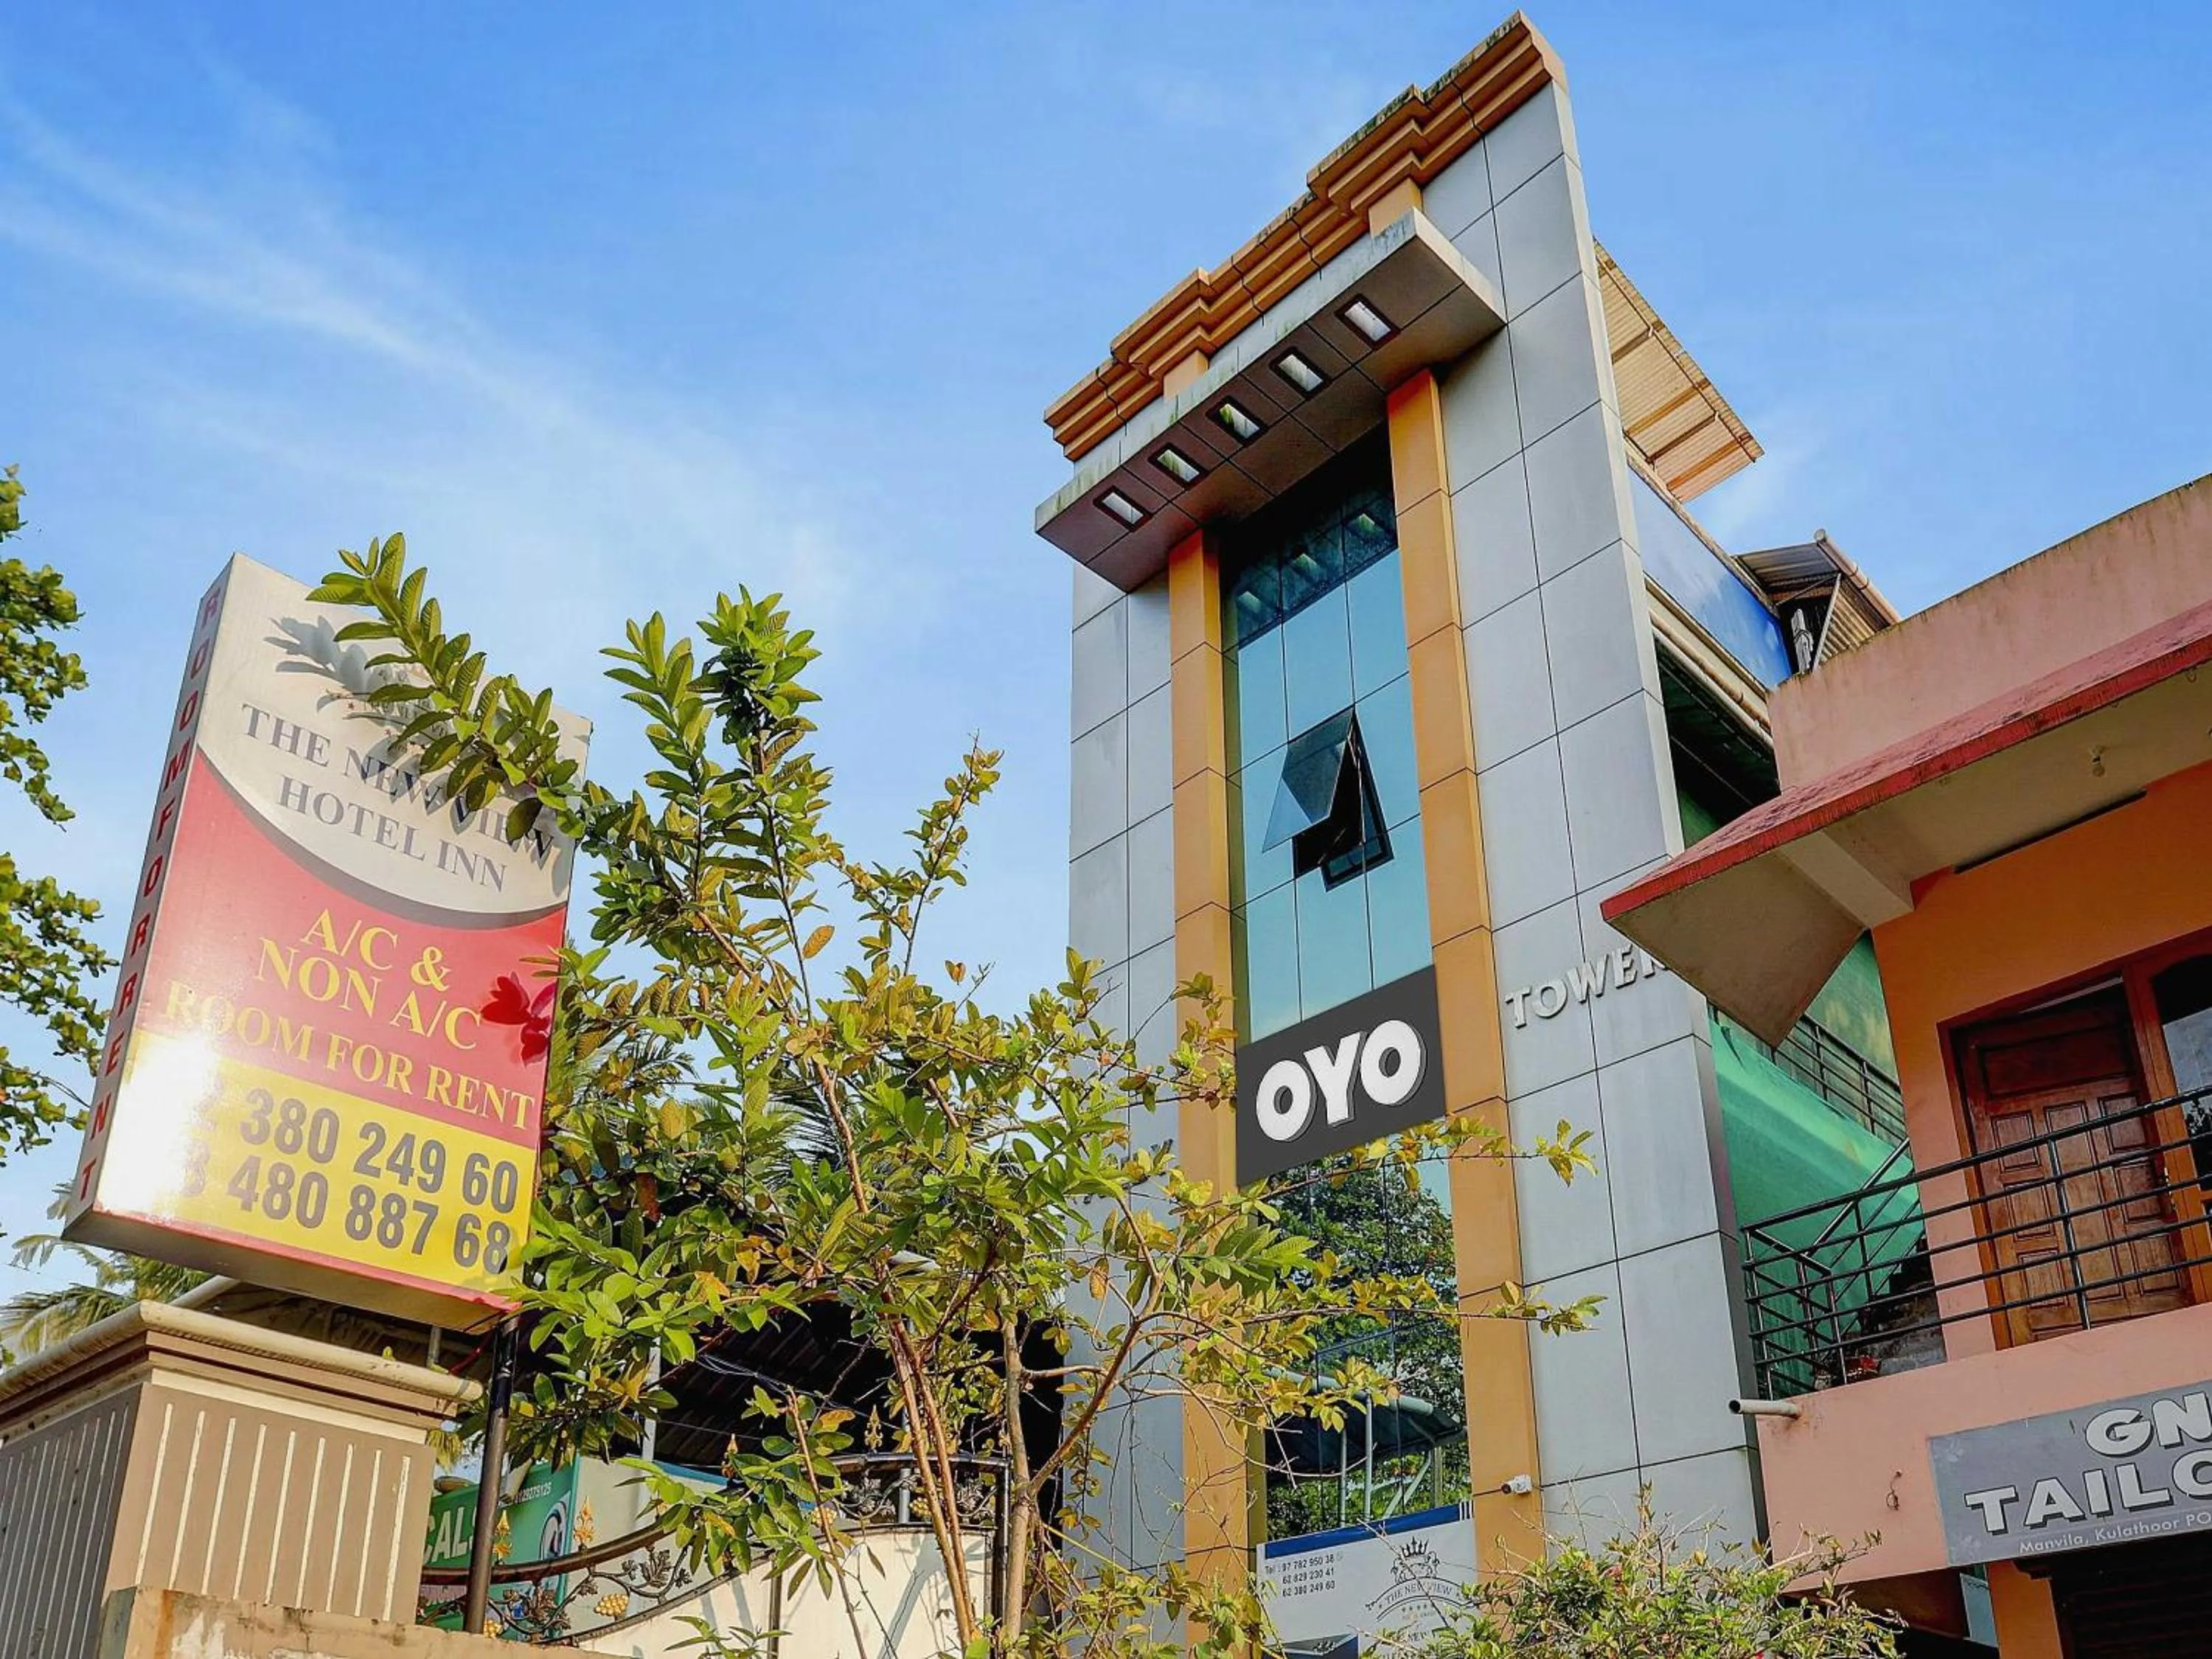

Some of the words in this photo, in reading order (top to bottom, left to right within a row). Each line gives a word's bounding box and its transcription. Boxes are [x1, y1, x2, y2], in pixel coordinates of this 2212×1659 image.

[242, 702, 331, 768] THE
[344, 746, 443, 813] NEW
[279, 776, 425, 861] HOTEL
[437, 838, 507, 893] INN
[256, 938, 381, 1018] NON
[390, 992, 482, 1050] A/C
[301, 907, 398, 972] A/C
[410, 946, 453, 992] &
[164, 979, 314, 1062] ROOM
[327, 1032, 414, 1095] FOR
[424, 1066, 536, 1130] RENT
[1256, 1020, 1425, 1142] OYO
[240, 1088, 340, 1164] 380
[354, 1122, 446, 1194] 249
[462, 1152, 518, 1214] 60
[226, 1155, 329, 1229] 480
[344, 1185, 438, 1255] 887
[453, 1213, 512, 1275] 68
[2085, 1391, 2212, 1458] GN
[2019, 1533, 2090, 1554] Manvila,
[2095, 1519, 2180, 1541] Kulathoor
